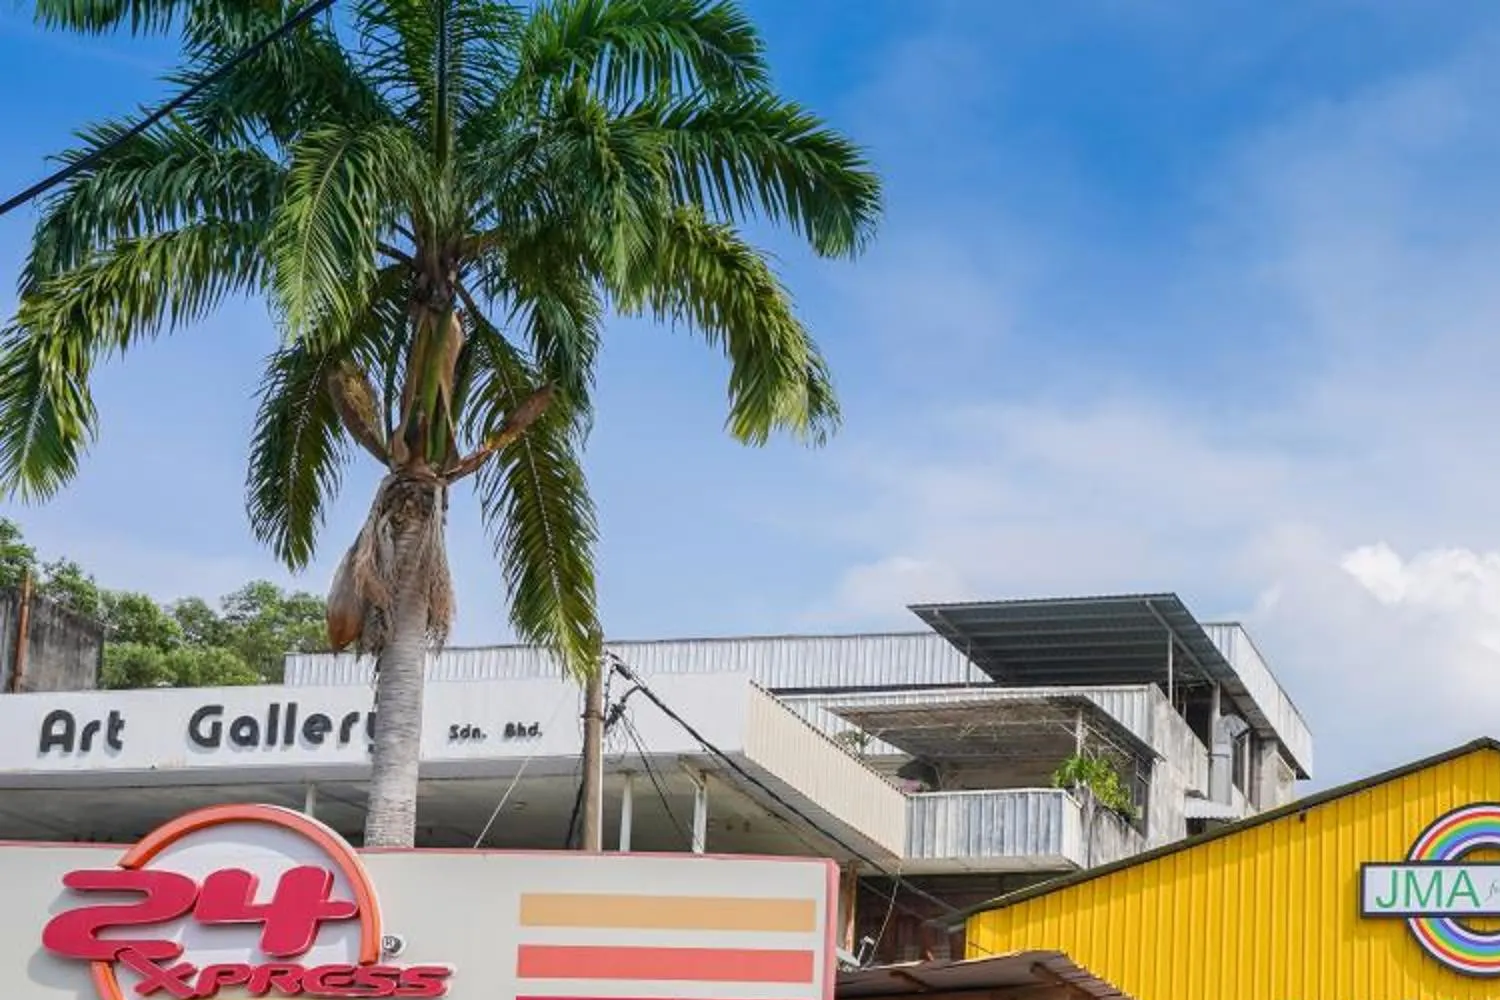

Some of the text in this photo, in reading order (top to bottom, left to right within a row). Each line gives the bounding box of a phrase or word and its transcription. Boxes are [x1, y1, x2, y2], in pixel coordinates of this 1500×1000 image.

[40, 709, 125, 752] Art
[449, 724, 487, 739] Sdn.
[505, 722, 543, 738] Bhd.
[42, 865, 360, 961] 24
[1375, 869, 1481, 909] JMA
[114, 946, 453, 1000] XPRESS
